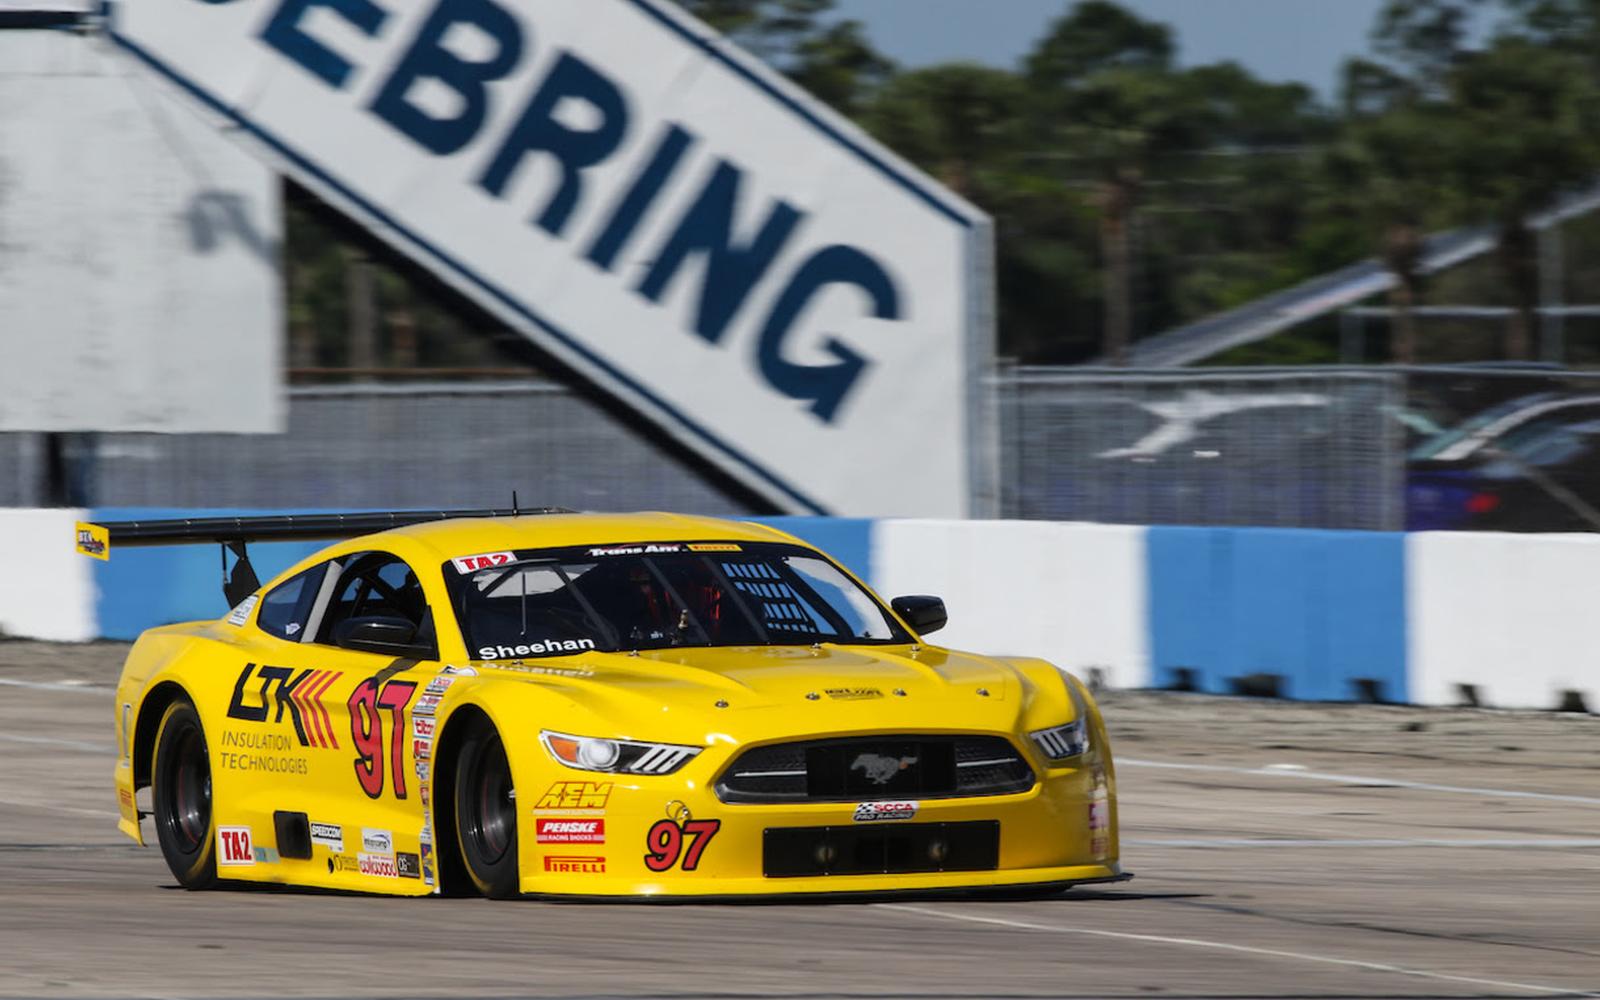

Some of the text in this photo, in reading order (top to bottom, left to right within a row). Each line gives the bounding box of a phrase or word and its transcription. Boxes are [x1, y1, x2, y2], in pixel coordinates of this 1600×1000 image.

[193, 0, 907, 427] EBRING
[460, 554, 508, 570] TA2
[586, 545, 681, 557] Trans Am
[479, 639, 595, 660] Sheehan
[226, 662, 315, 747] LTK
[221, 731, 293, 751] INSULATION
[347, 677, 418, 801] 97
[220, 752, 309, 775] TECHNOLOGIES
[534, 781, 614, 809] AEM
[874, 803, 913, 812] SCCA
[542, 822, 598, 833] PENSKE
[221, 831, 252, 861] TA2
[644, 819, 721, 872] 97
[544, 856, 606, 873] PIRELLI
